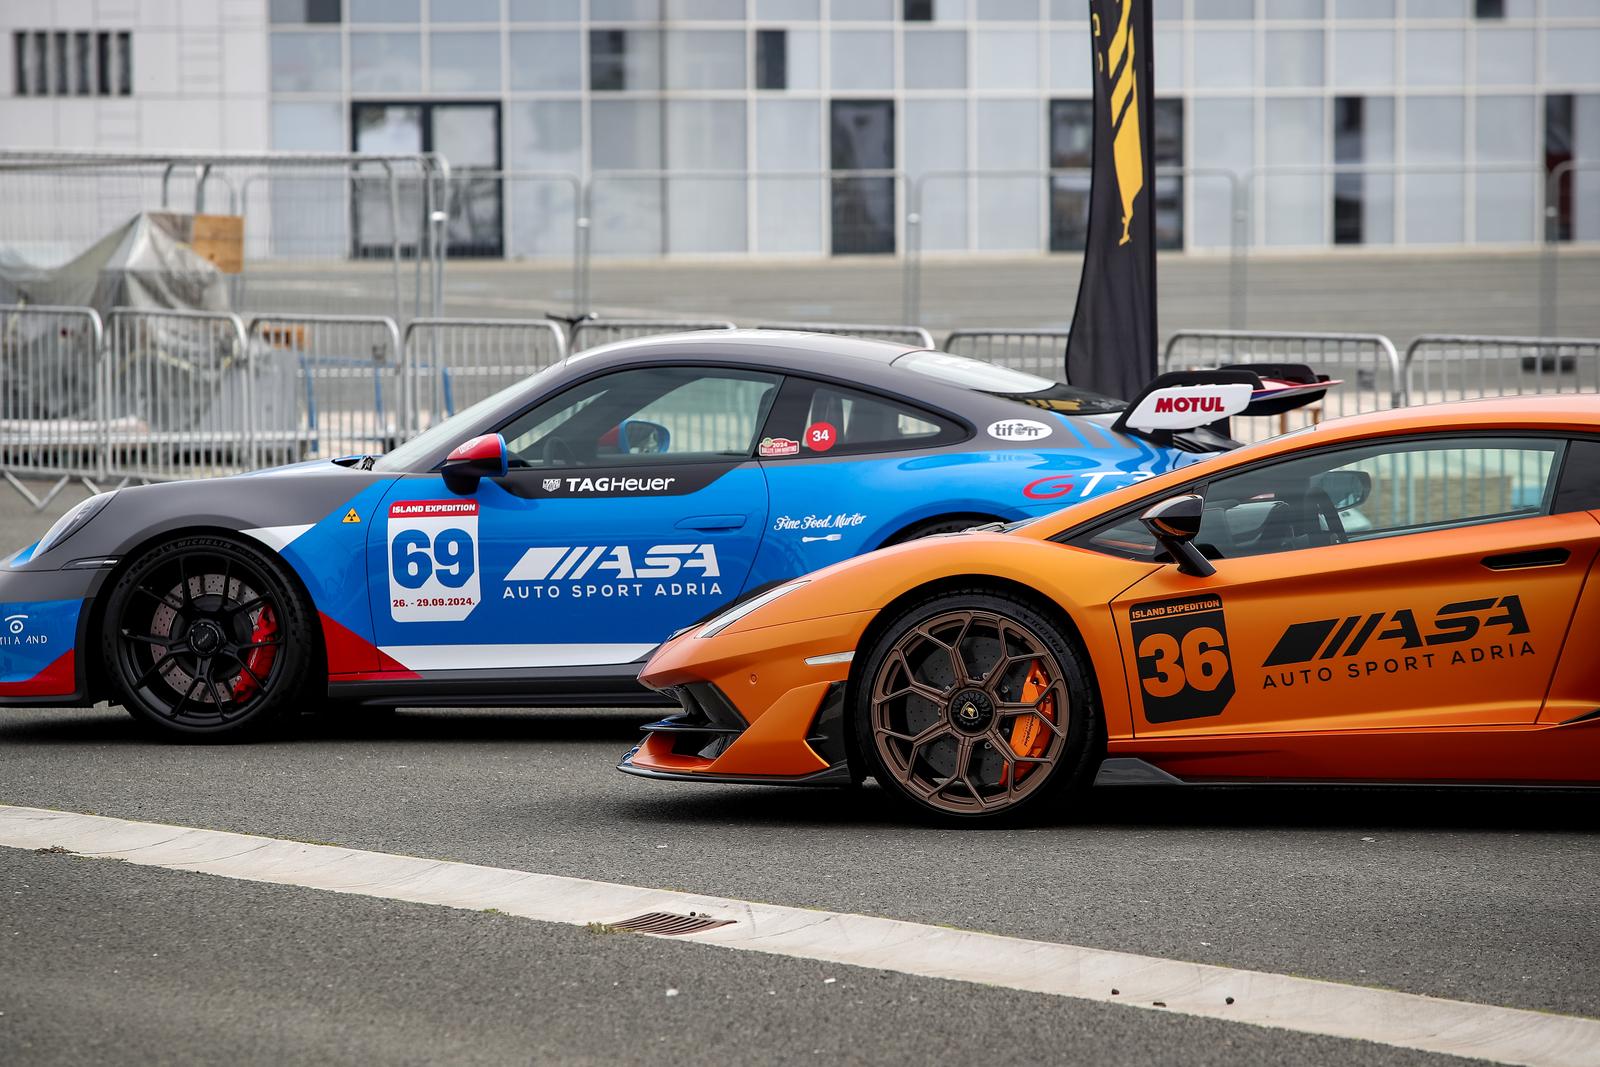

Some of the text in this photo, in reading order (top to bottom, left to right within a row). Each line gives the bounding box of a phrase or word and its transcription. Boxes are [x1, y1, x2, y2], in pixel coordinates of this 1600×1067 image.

[1155, 397, 1225, 413] MOTUL
[812, 429, 829, 442] 34
[392, 503, 476, 514] ISLAND EXPEDITION
[773, 515, 800, 531] Fine
[801, 514, 832, 530] Food
[391, 528, 476, 589] 69
[502, 582, 723, 600] AUTO SPORT ADRIA
[392, 599, 409, 608] 26.
[416, 597, 475, 607] 29.09.2024.
[1132, 599, 1220, 620] ISLAND EXPEDITION
[1138, 626, 1230, 698] 36
[1262, 640, 1536, 690] AUTO SPORT ADRIA
